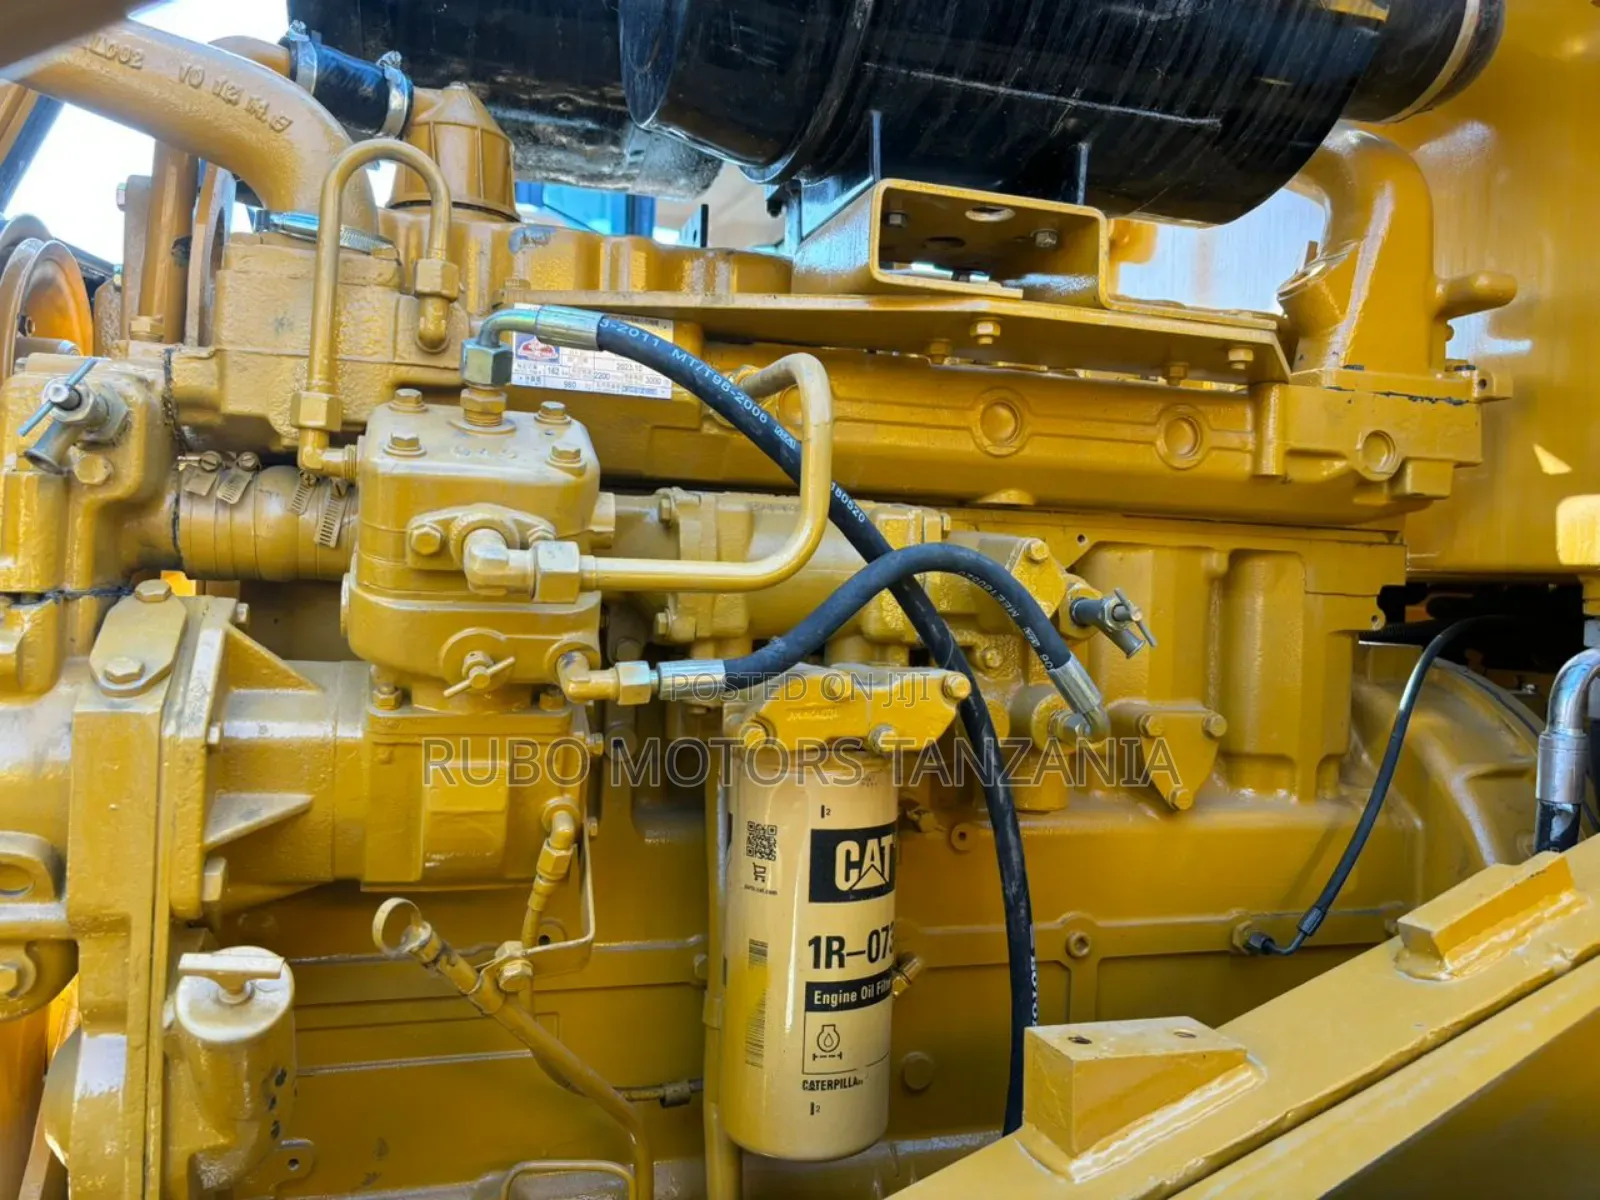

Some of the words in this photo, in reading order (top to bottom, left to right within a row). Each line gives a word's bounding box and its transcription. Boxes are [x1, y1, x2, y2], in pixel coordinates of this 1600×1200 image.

[834, 834, 895, 892] CAT
[814, 990, 858, 1008] Engine
[861, 984, 875, 999] Oil
